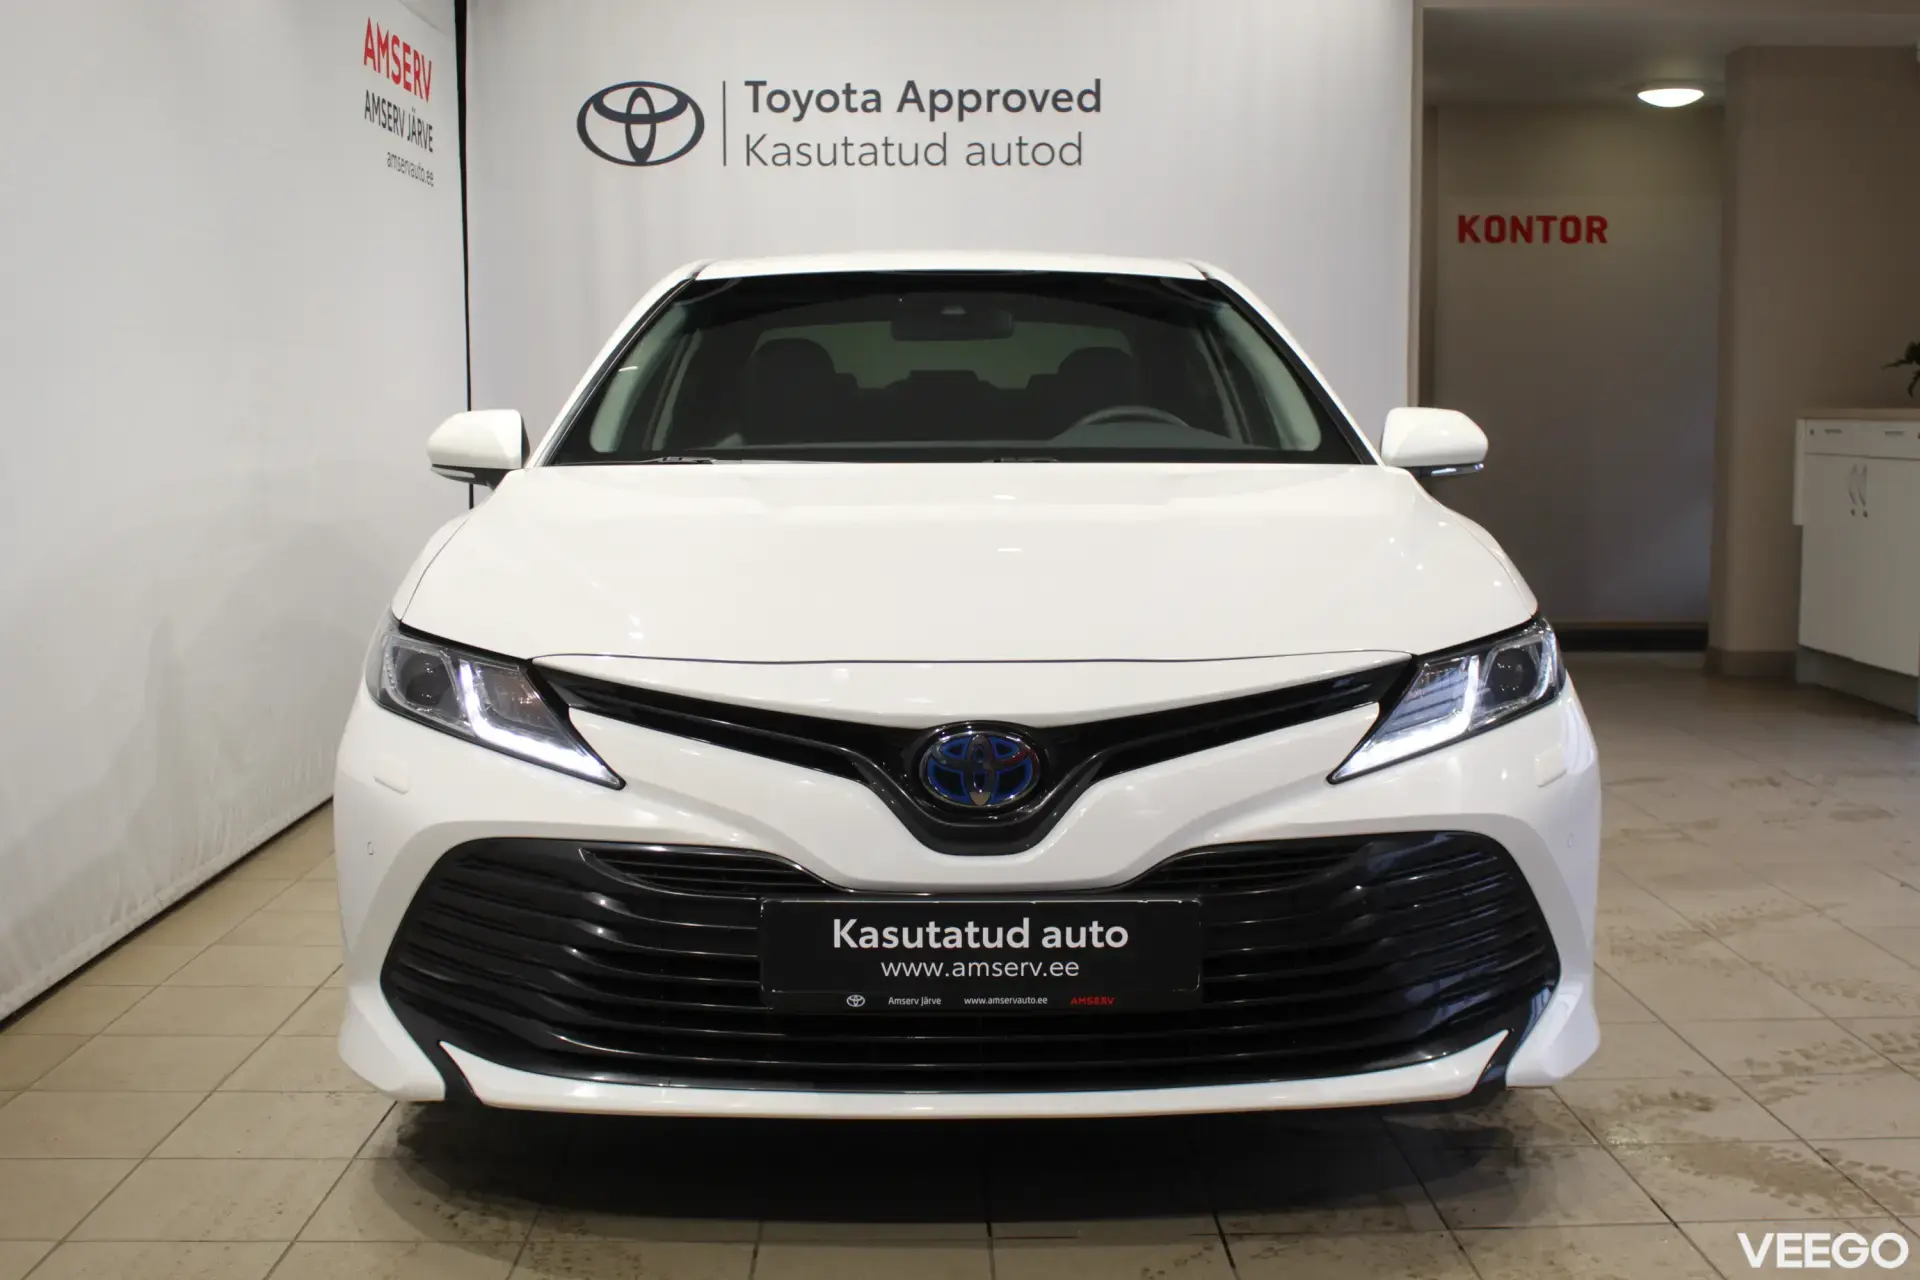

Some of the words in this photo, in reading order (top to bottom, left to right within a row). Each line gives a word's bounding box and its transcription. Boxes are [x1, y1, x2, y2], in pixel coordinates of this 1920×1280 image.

[363, 16, 432, 103] AMSERV
[744, 80, 882, 122] Toyota
[896, 78, 1102, 122] Approved
[364, 89, 405, 138] AMSERV
[407, 106, 433, 152] JÄRVE
[745, 132, 948, 167] Kasutatud
[965, 132, 1083, 167] autod
[386, 151, 434, 187] amservauto.ee
[1457, 214, 1608, 244] KONTOR
[833, 918, 1030, 949] Kasutatud
[1041, 922, 1129, 949] auto
[881, 959, 1080, 977] www.amserv.ee
[888, 996, 920, 1005] Amserv
[921, 995, 942, 1006] Järve
[963, 995, 1048, 1005] www.amservauto.ee
[1070, 996, 1115, 1005] AMSERV
